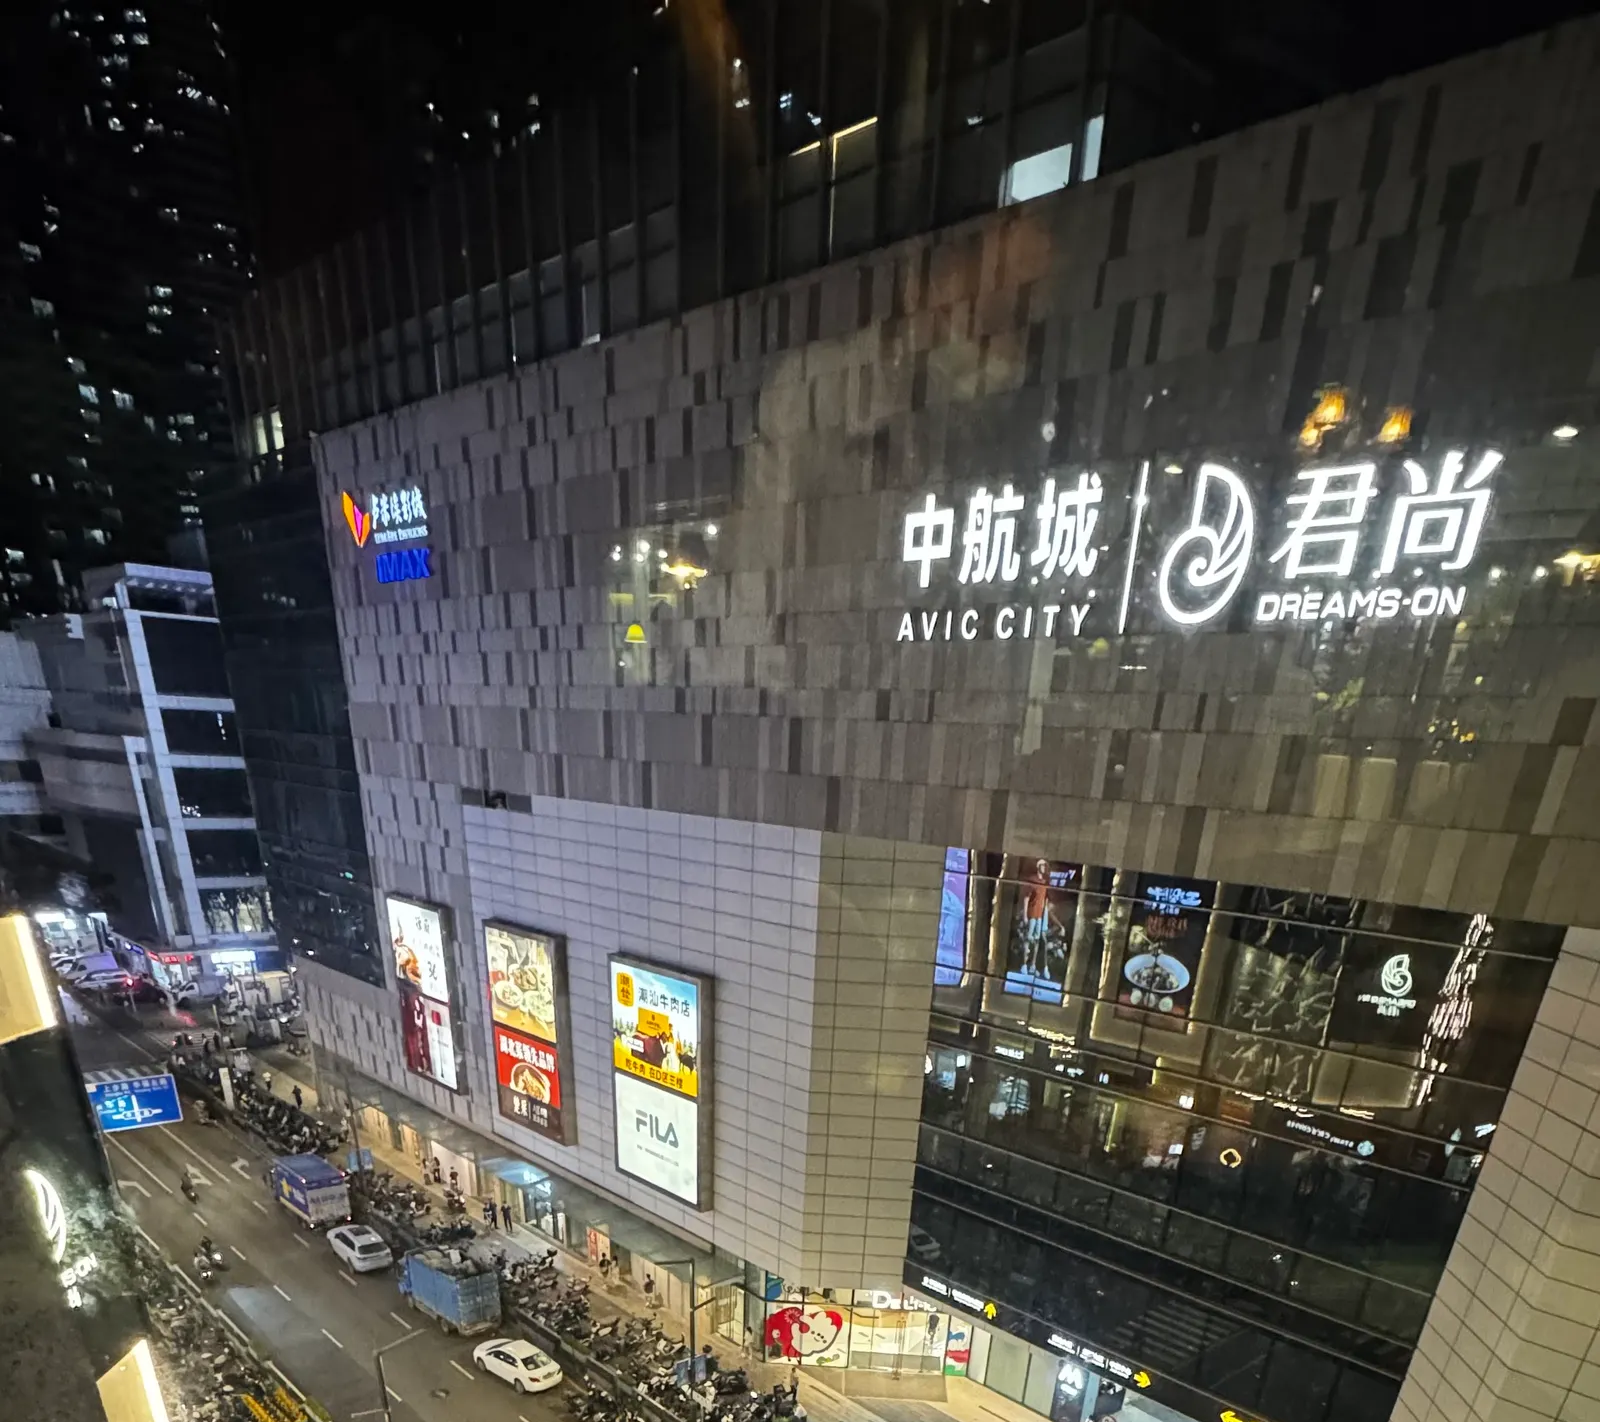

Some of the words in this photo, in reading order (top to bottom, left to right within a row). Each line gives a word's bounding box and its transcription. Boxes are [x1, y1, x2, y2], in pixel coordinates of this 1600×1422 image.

[902, 470, 1104, 589] 中航城
[1269, 449, 1504, 580] 君尚
[376, 548, 431, 584] IMAX
[1255, 585, 1467, 622] DREAMS-ON
[897, 609, 980, 642] AVIC
[995, 604, 1091, 639] CITY
[638, 987, 690, 1018] 潮汕牛肉店
[636, 1108, 679, 1149] FILA
